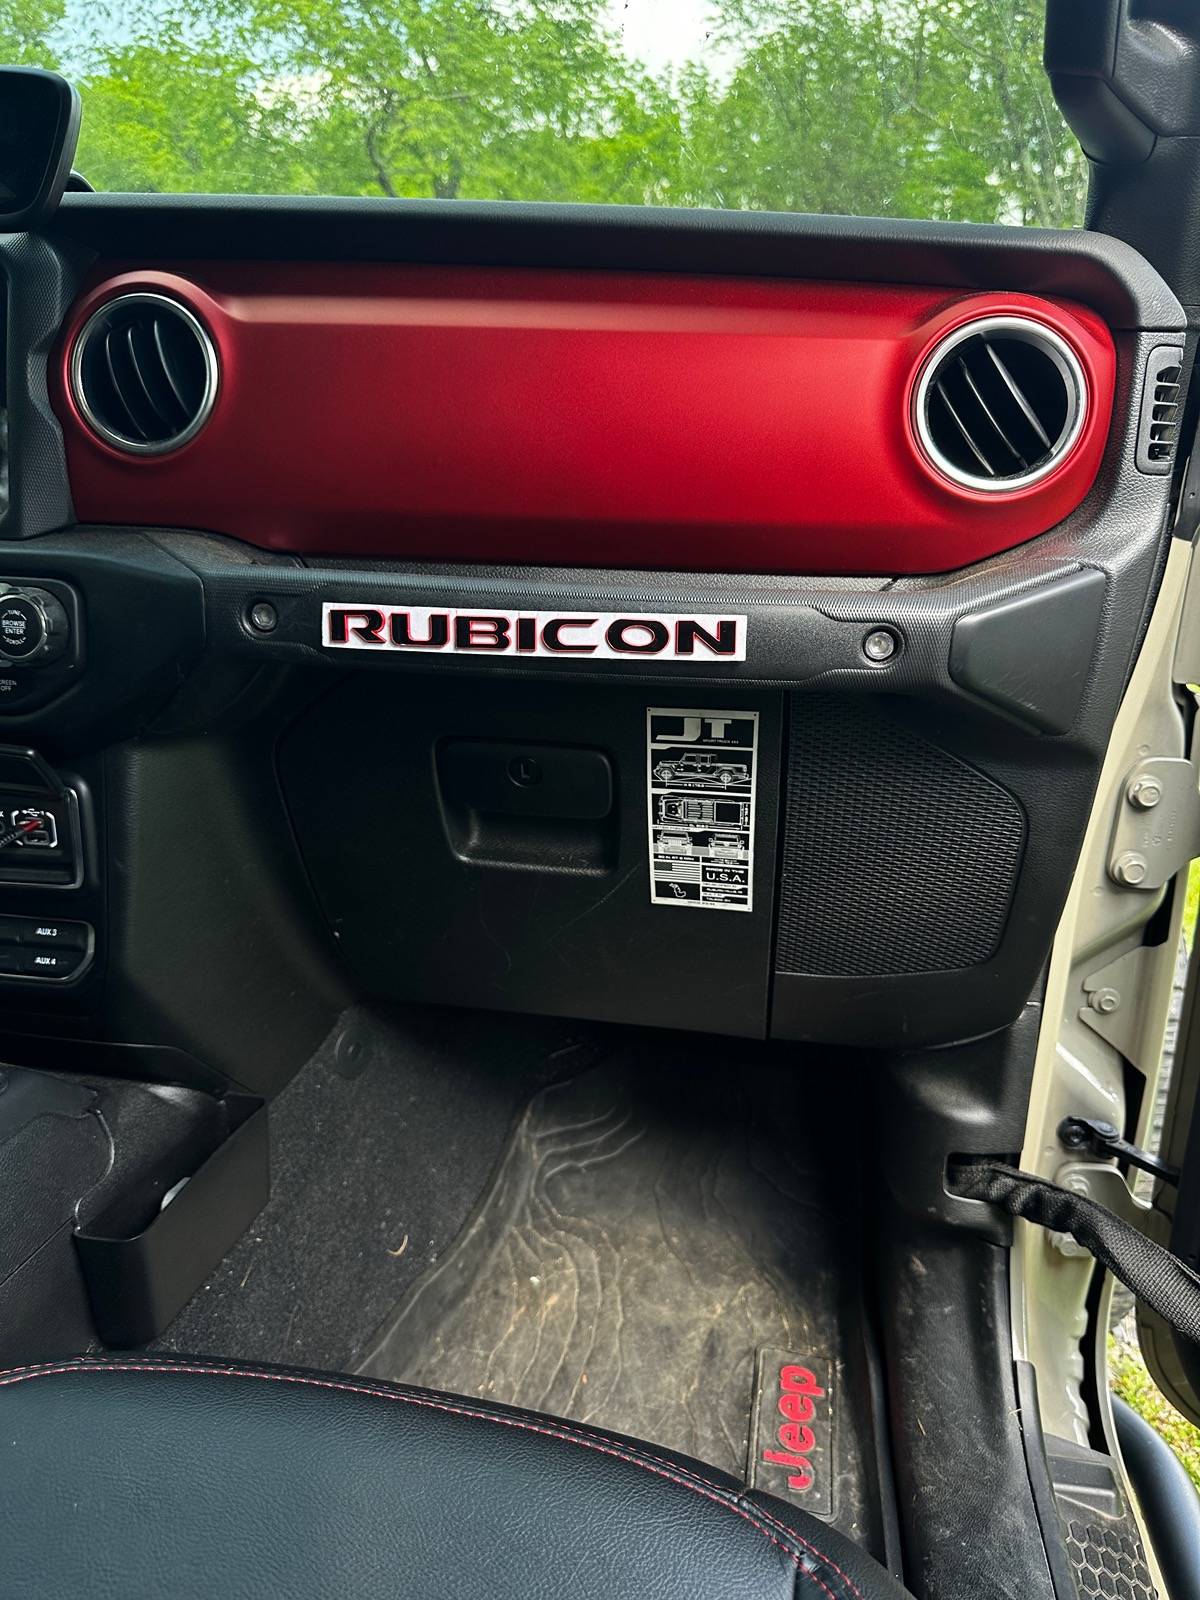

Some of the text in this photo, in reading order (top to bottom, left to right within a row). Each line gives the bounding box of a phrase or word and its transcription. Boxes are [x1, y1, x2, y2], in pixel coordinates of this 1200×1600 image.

[328, 607, 738, 656] RUBICON
[656, 717, 732, 742] JT
[706, 872, 745, 883] U.S.A.
[35, 927, 58, 937] AUX 3
[33, 956, 57, 966] AUX 4
[762, 1364, 826, 1493] Jeep
